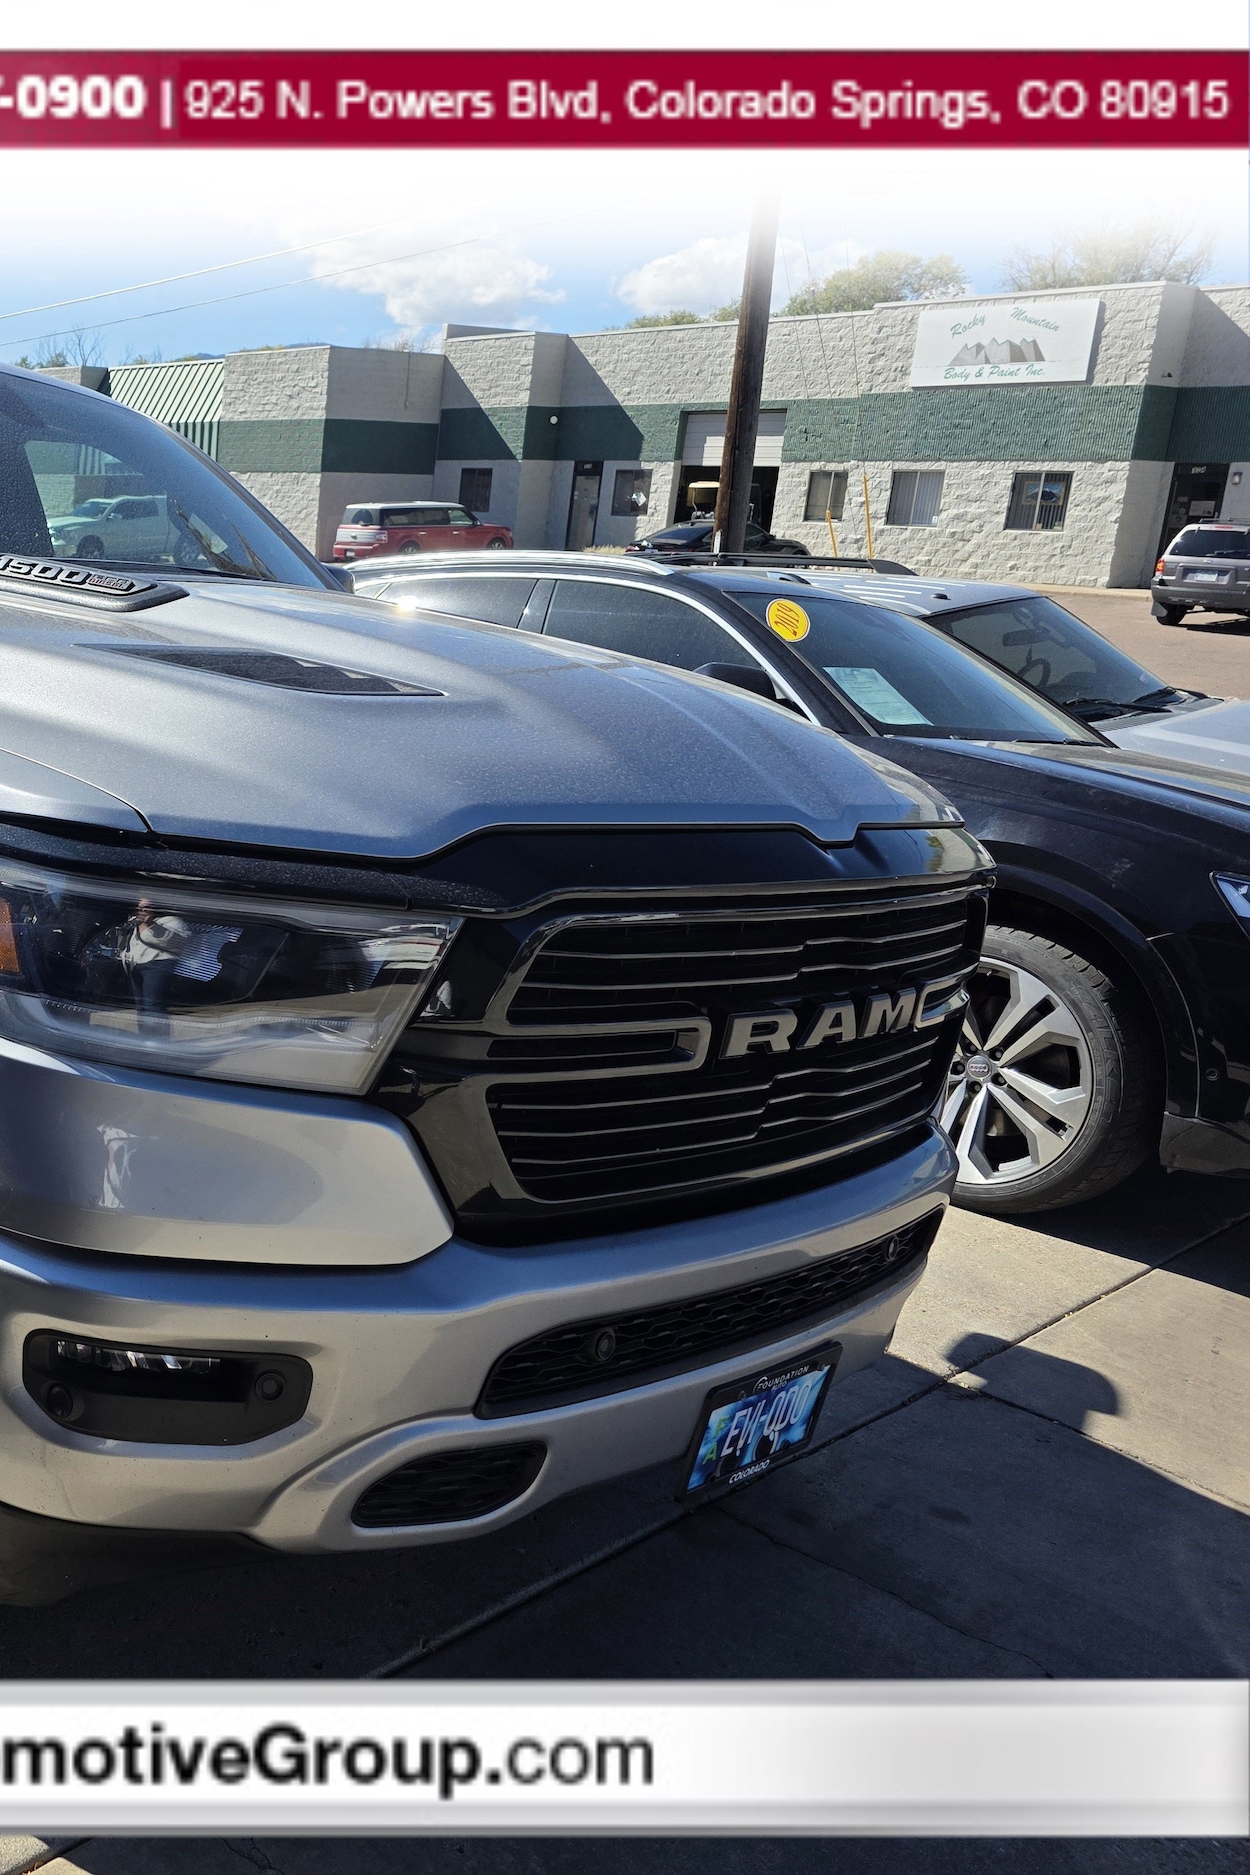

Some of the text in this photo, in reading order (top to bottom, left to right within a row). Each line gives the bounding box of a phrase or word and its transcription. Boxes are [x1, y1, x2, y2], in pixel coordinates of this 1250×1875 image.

[950, 306, 1061, 339] Rocky Mountain
[943, 367, 972, 381] Body
[988, 364, 1020, 378] Paint
[1024, 363, 1046, 377] Inc.
[774, 602, 800, 637] 2019
[720, 987, 918, 1060] RAM
[753, 1364, 810, 1393] FOUNDATION
[728, 1459, 771, 1484] COLORADO
